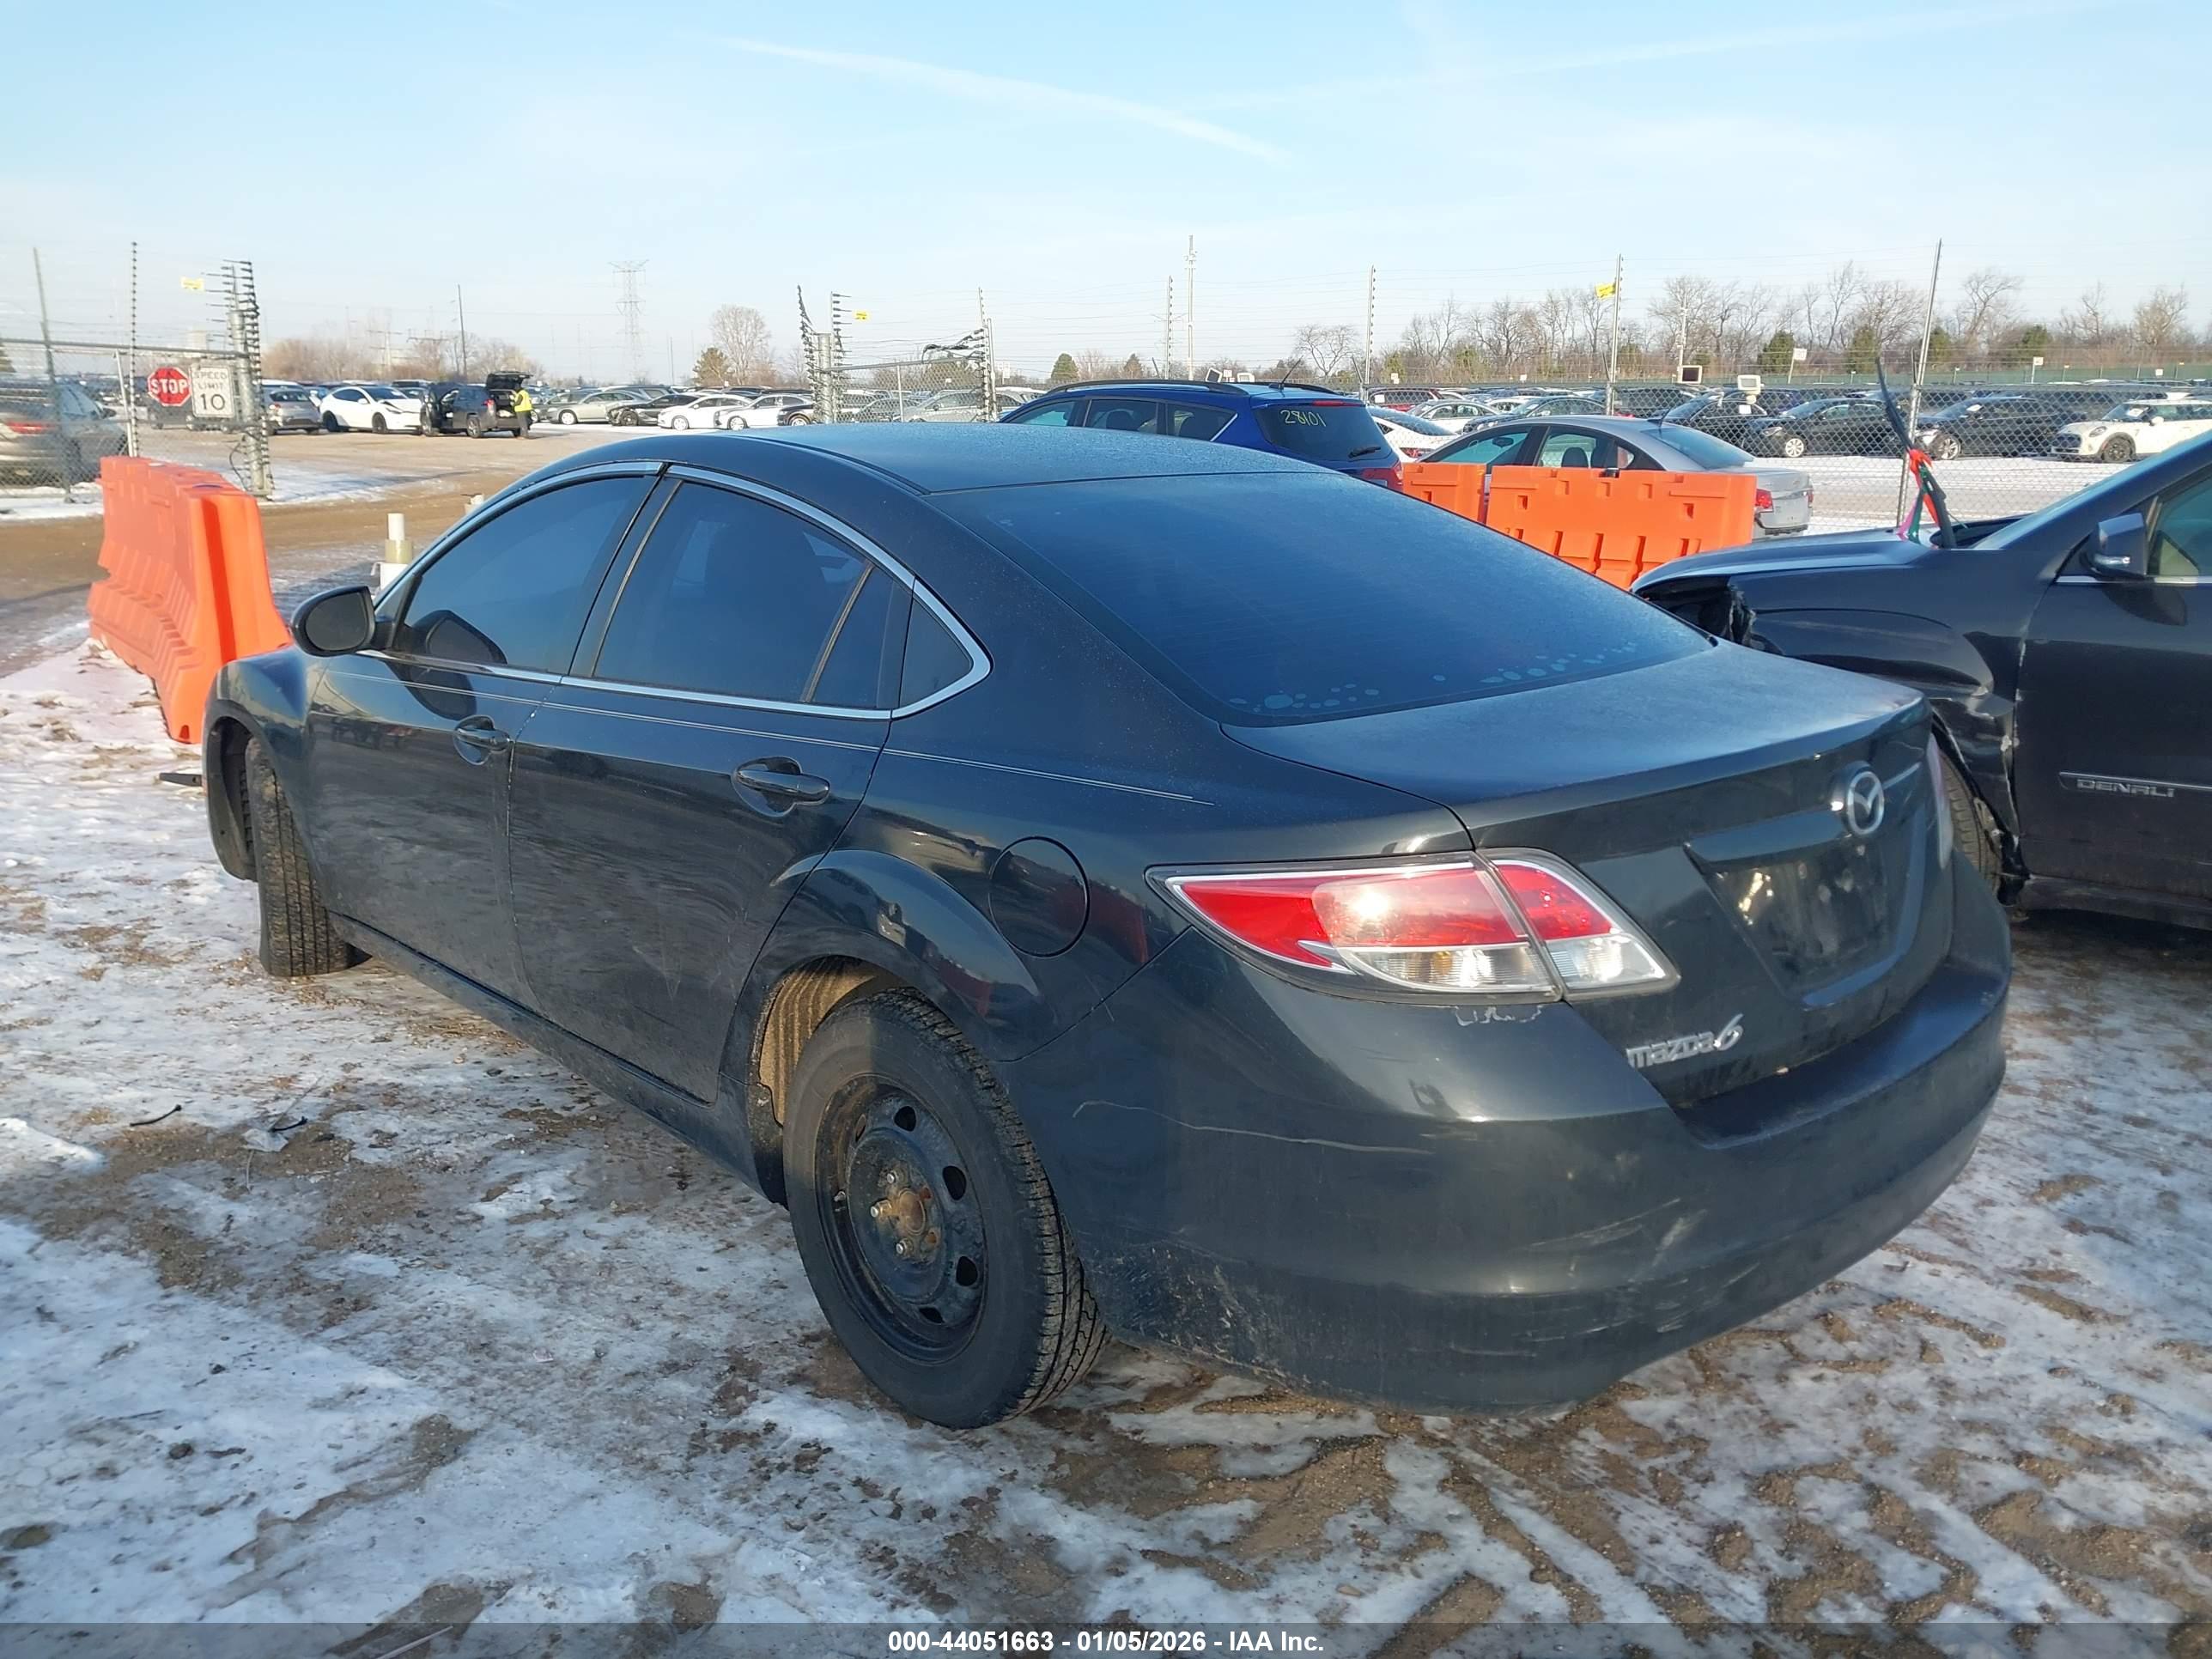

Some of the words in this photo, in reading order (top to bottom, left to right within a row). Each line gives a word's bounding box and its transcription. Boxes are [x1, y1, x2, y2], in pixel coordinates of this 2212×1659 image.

[151, 378, 188, 394] STOP
[200, 393, 225, 410] 10
[1280, 410, 1327, 427] 28101
[2077, 779, 2175, 798] DENALI
